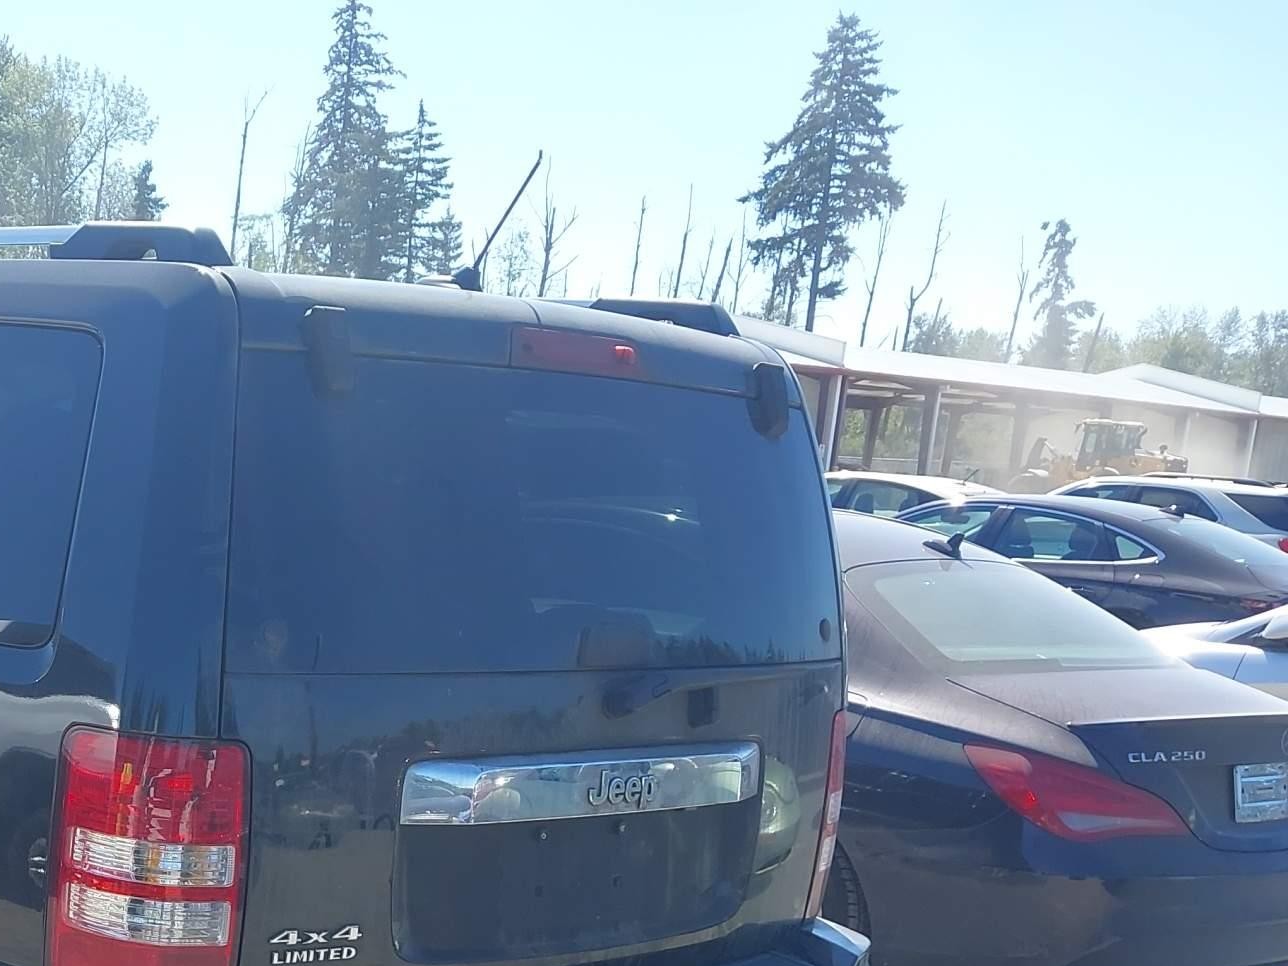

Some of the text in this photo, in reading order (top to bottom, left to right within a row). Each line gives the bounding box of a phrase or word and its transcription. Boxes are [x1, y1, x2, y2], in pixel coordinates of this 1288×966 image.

[1128, 751, 1206, 763] CLA 250
[587, 768, 657, 809] Jeep
[271, 946, 357, 965] LIMITED
